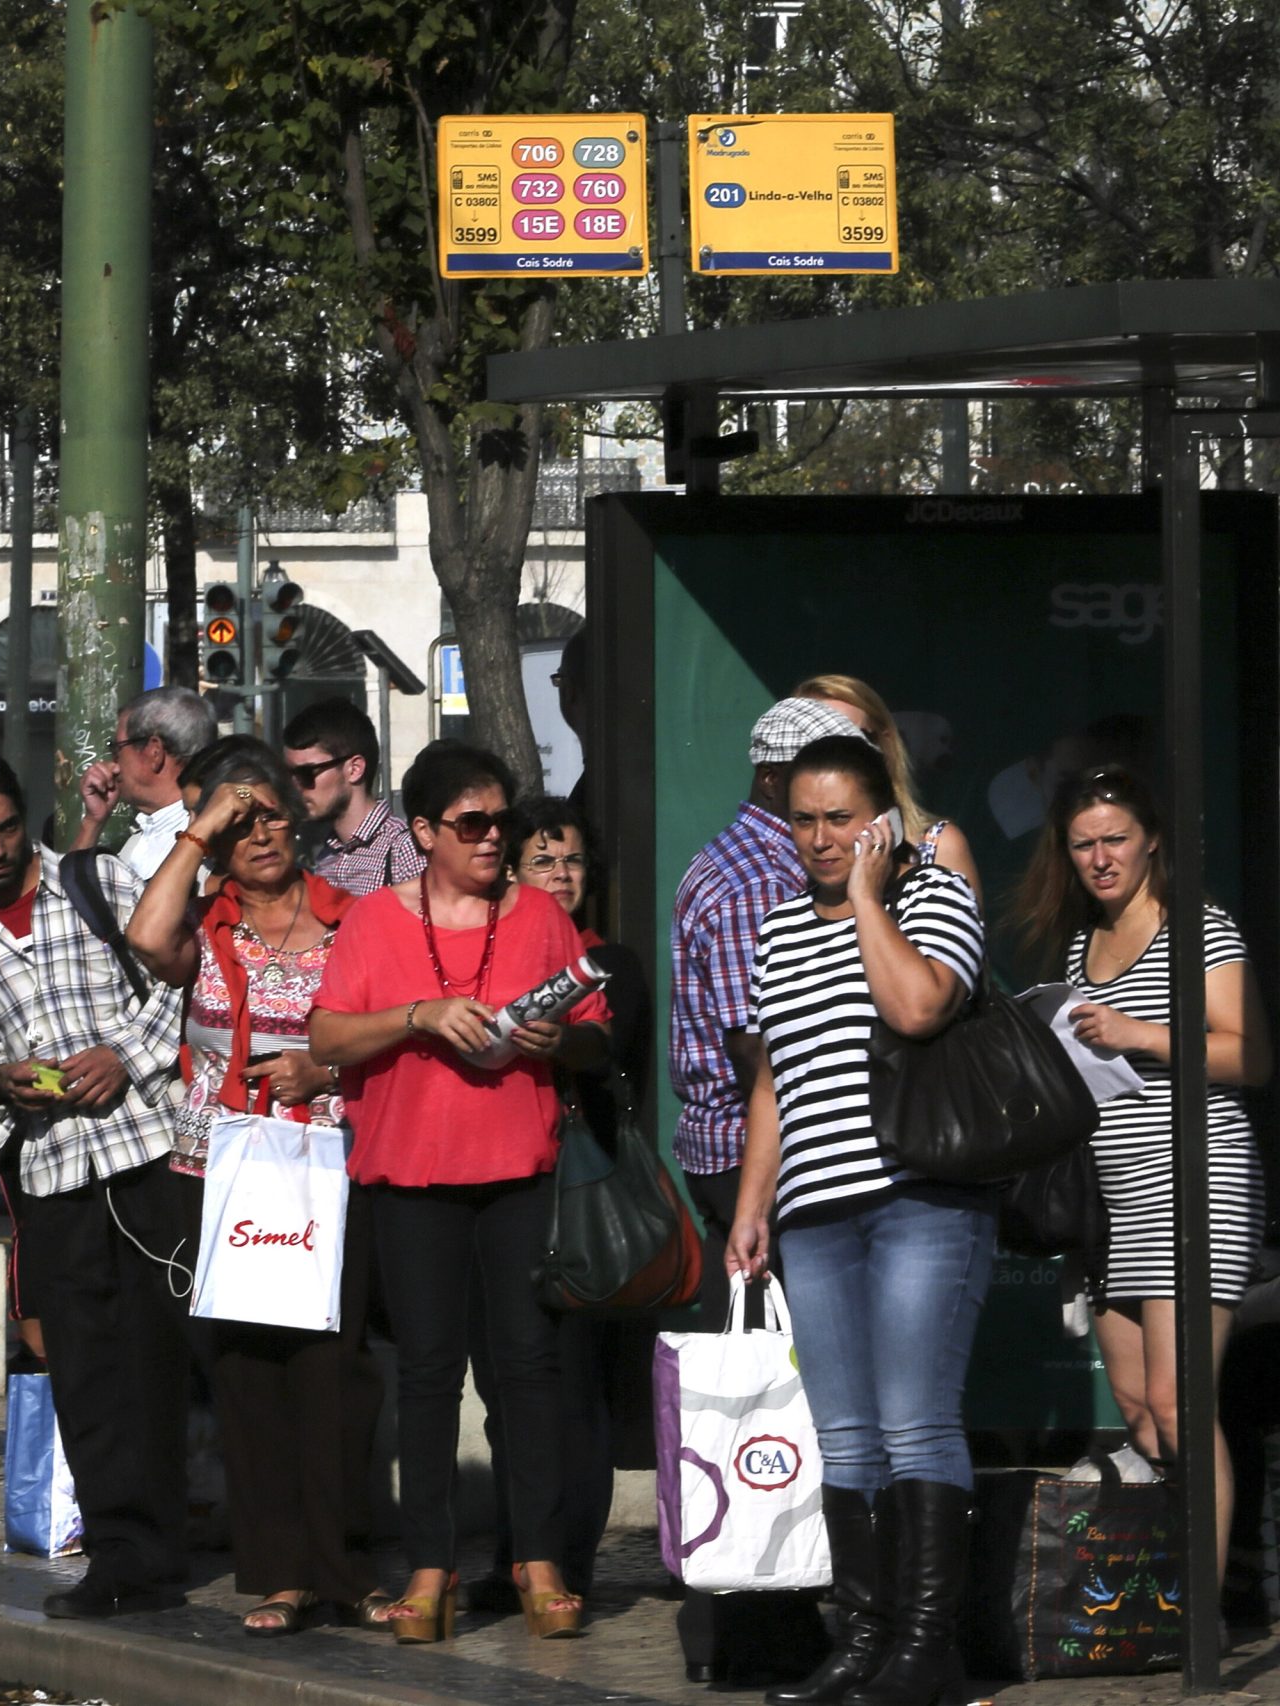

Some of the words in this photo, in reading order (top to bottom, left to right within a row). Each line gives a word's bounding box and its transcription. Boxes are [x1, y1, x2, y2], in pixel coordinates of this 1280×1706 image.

[519, 145, 557, 161] 706
[580, 145, 619, 161] 728
[477, 173, 498, 182] SMS
[863, 172, 884, 181] SMS
[519, 181, 558, 197] 732
[580, 181, 619, 197] 760
[709, 188, 740, 202] 201
[748, 191, 833, 201] Linda-a-Velha
[454, 197, 462, 207] C
[466, 197, 498, 207] 03802
[841, 197, 849, 206] C
[852, 197, 884, 206] 03802
[520, 216, 559, 233] 15E
[582, 215, 620, 233] 18E
[455, 228, 497, 242] 3599
[842, 226, 884, 241] 3599
[517, 257, 540, 267] Cais
[542, 257, 574, 267] Sodré
[768, 256, 792, 266] Cais
[794, 255, 825, 266] Sodré
[904, 500, 1023, 523] JCDecaux
[228, 1219, 316, 1251] Simel
[745, 1450, 790, 1474] C&A
